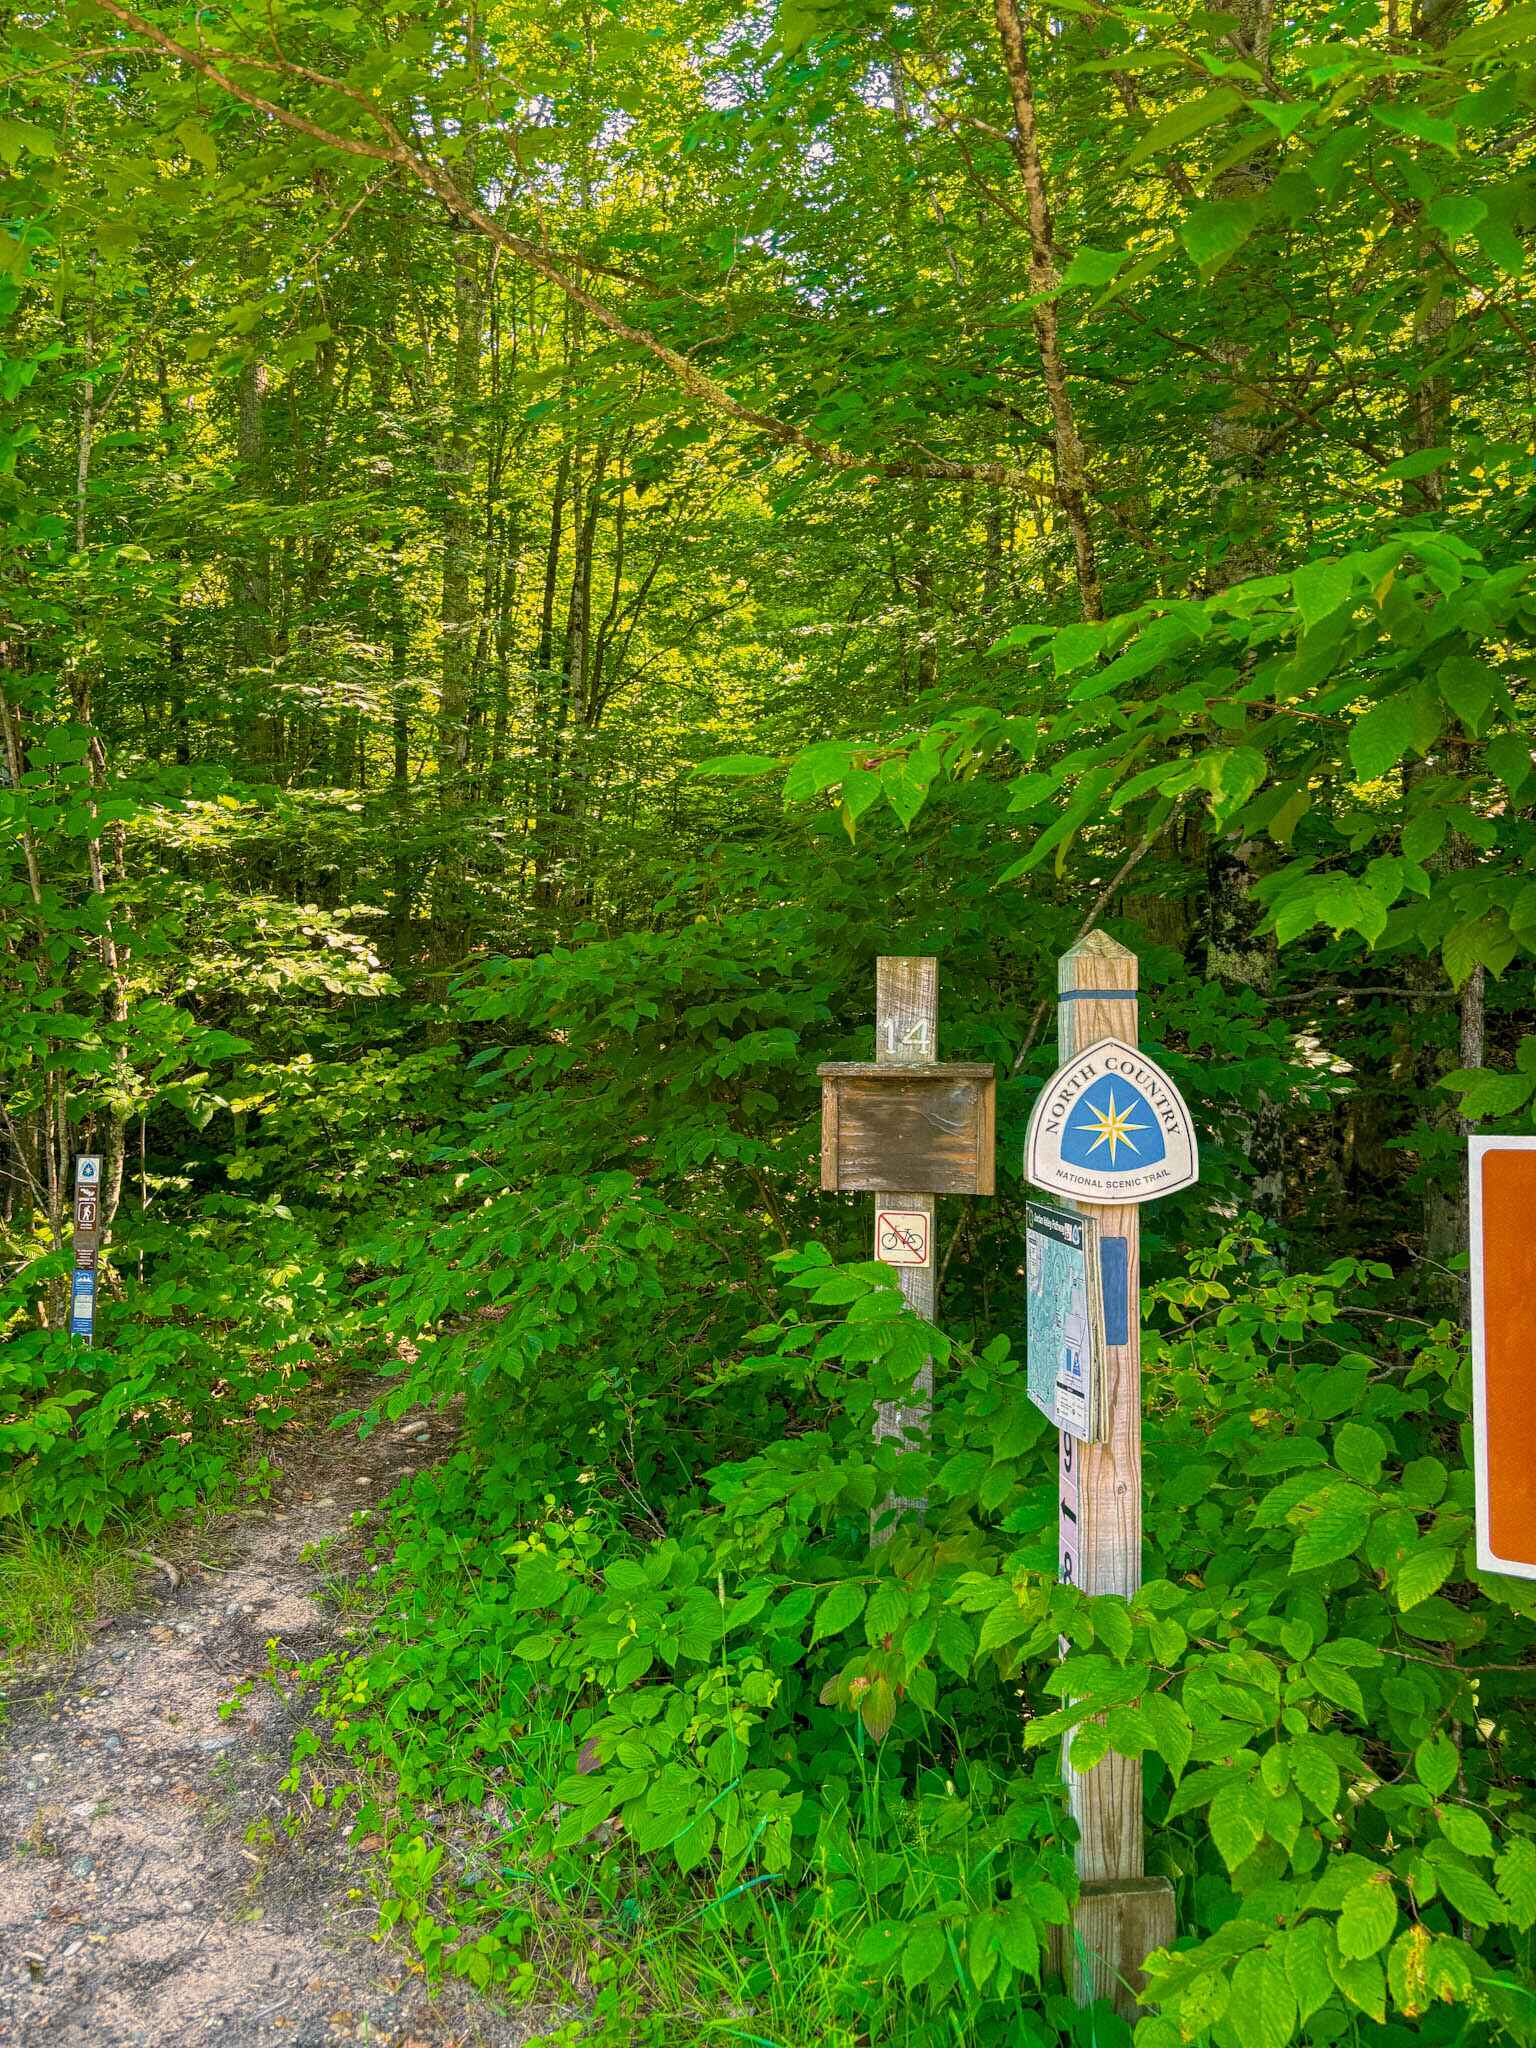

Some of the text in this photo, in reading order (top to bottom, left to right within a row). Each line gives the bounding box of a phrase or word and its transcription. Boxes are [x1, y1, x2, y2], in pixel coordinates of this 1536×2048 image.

[881, 1017, 931, 1055] 14
[1046, 1057, 1181, 1136] NORTH COUNTRY
[1056, 1169, 1171, 1189] NATIONAL SCENIC TRAIL
